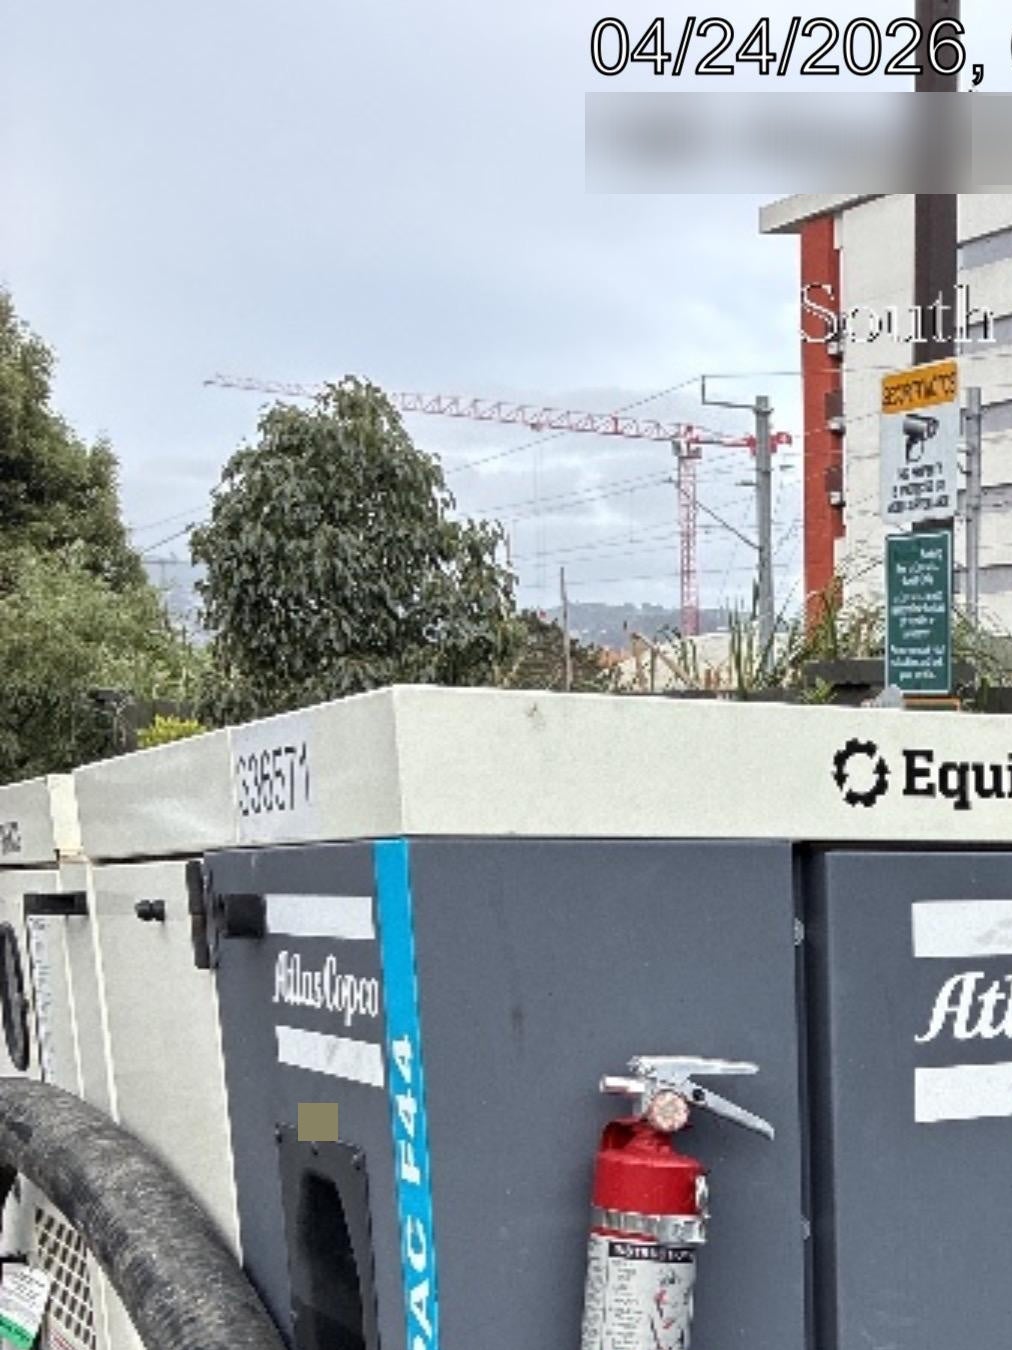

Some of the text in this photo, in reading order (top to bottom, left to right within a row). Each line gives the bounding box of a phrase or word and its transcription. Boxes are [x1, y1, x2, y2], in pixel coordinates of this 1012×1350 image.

[237, 741, 310, 816] 336571
[272, 950, 379, 1026] Atlas Copco
[393, 1033, 421, 1186] F44
